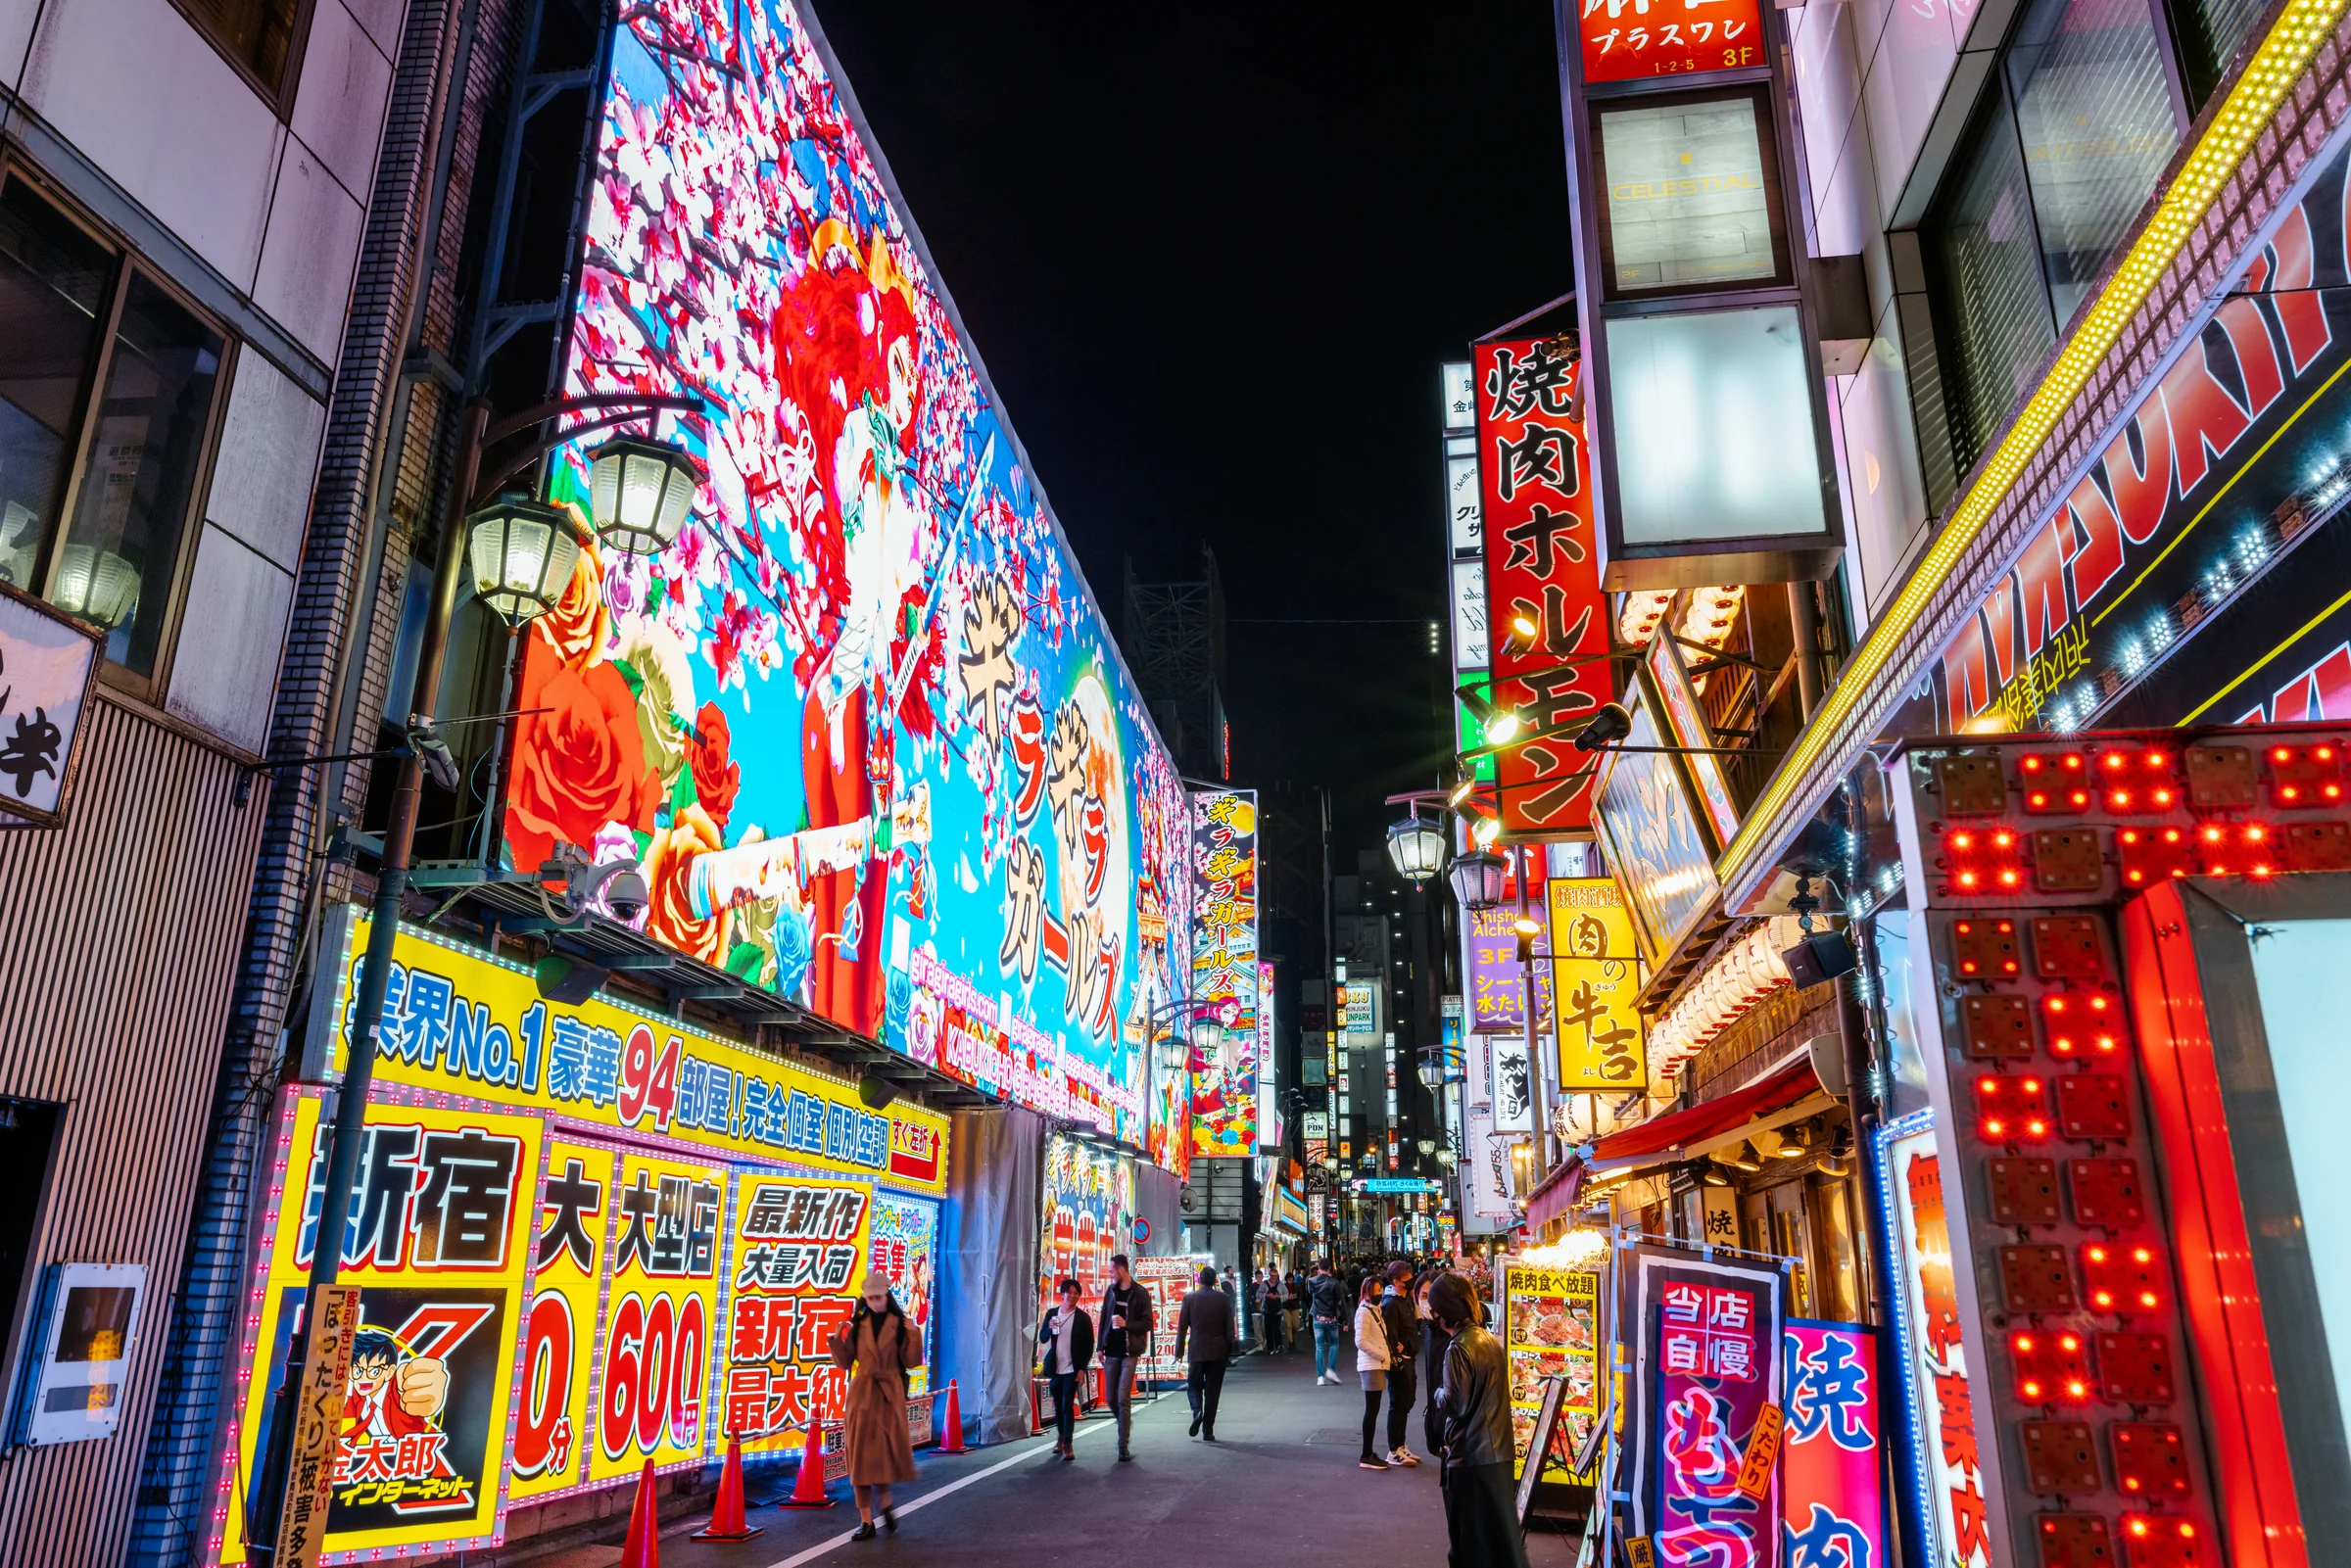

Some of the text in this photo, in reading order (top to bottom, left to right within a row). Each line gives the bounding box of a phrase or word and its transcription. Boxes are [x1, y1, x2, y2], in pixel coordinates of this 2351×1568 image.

[1591, 20, 1746, 54] プラスワン
[1655, 46, 1753, 73] 1-2-5 3F
[1613, 173, 1759, 201] CELESTIAL
[1621, 269, 1640, 279] 2F
[1457, 505, 1481, 521] クリ
[1485, 343, 1600, 825] 焼肉ホルモン
[1209, 795, 1238, 994] ギラギラガールズ
[1477, 948, 1513, 965] 3F
[910, 946, 999, 1027] giragiragirls.com
[1346, 1013, 1370, 1022] UNPARK
[945, 1022, 1014, 1094] KABUKICHO
[825, 1098, 890, 1171] 個別空調
[892, 1116, 930, 1158] すぐ左折
[295, 1123, 525, 1272] 新宿
[742, 1183, 868, 1244] 最新作
[614, 1168, 723, 1279] 大型店
[735, 1242, 858, 1293] 大量入荷
[1510, 1271, 1595, 1296] 焼肉食べ放題
[313, 1290, 359, 1513] 客引きにはついていかない
[826, 1429, 846, 1455] 駐車
[1746, 1408, 1779, 1488] こだわり
[339, 1475, 474, 1506] インターネット
